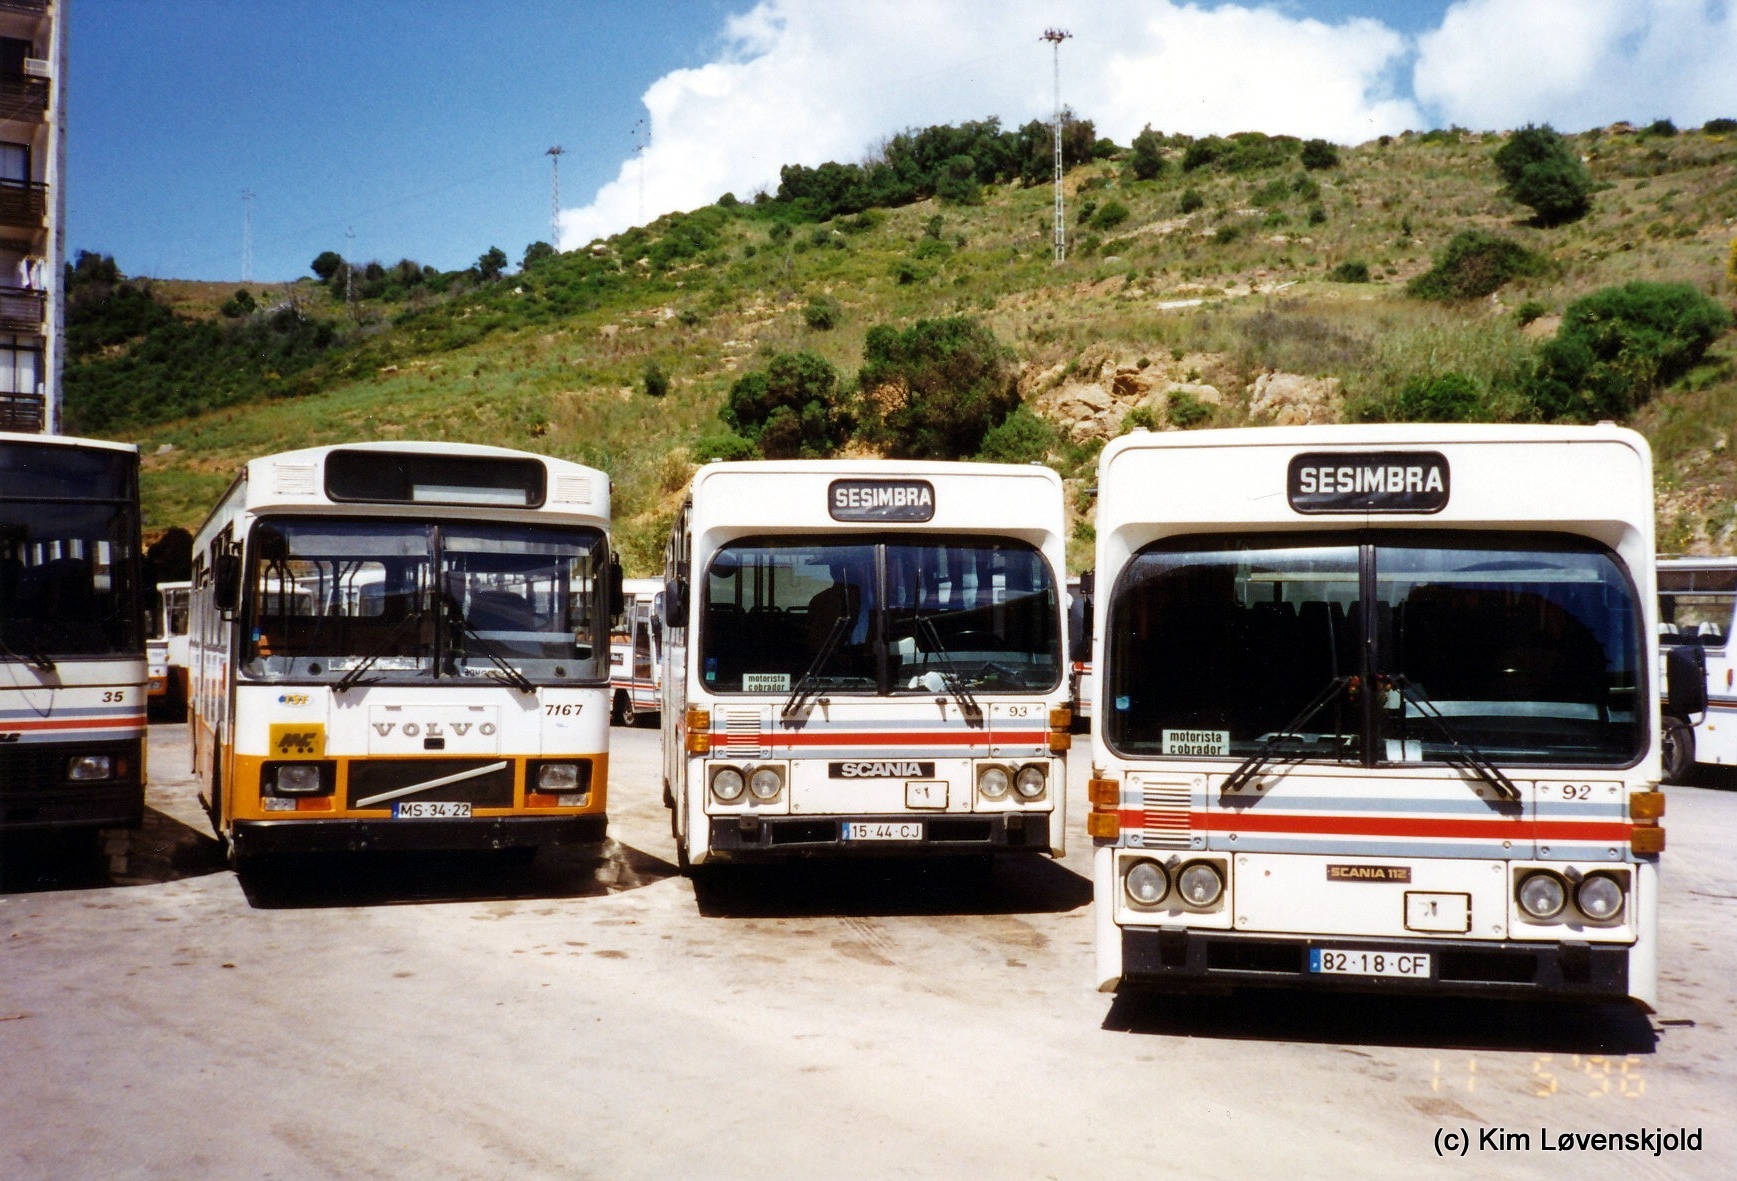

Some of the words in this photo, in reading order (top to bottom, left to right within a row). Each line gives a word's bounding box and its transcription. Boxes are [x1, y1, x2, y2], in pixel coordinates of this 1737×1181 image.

[1300, 466, 1444, 494] SESIMBRA
[835, 487, 932, 507] SESIMBRA
[748, 674, 786, 683] motorista
[748, 683, 786, 692] cobrador
[102, 691, 124, 703] 35
[545, 704, 583, 716] 7167
[1009, 706, 1028, 718] 93
[372, 722, 497, 737] VOLVO
[1169, 731, 1222, 743] motorista
[1169, 743, 1222, 756] cobrador
[841, 762, 923, 777] SCANIA
[1562, 784, 1591, 800] 92
[1330, 867, 1385, 879] SCANIA
[1387, 869, 1408, 880] 112
